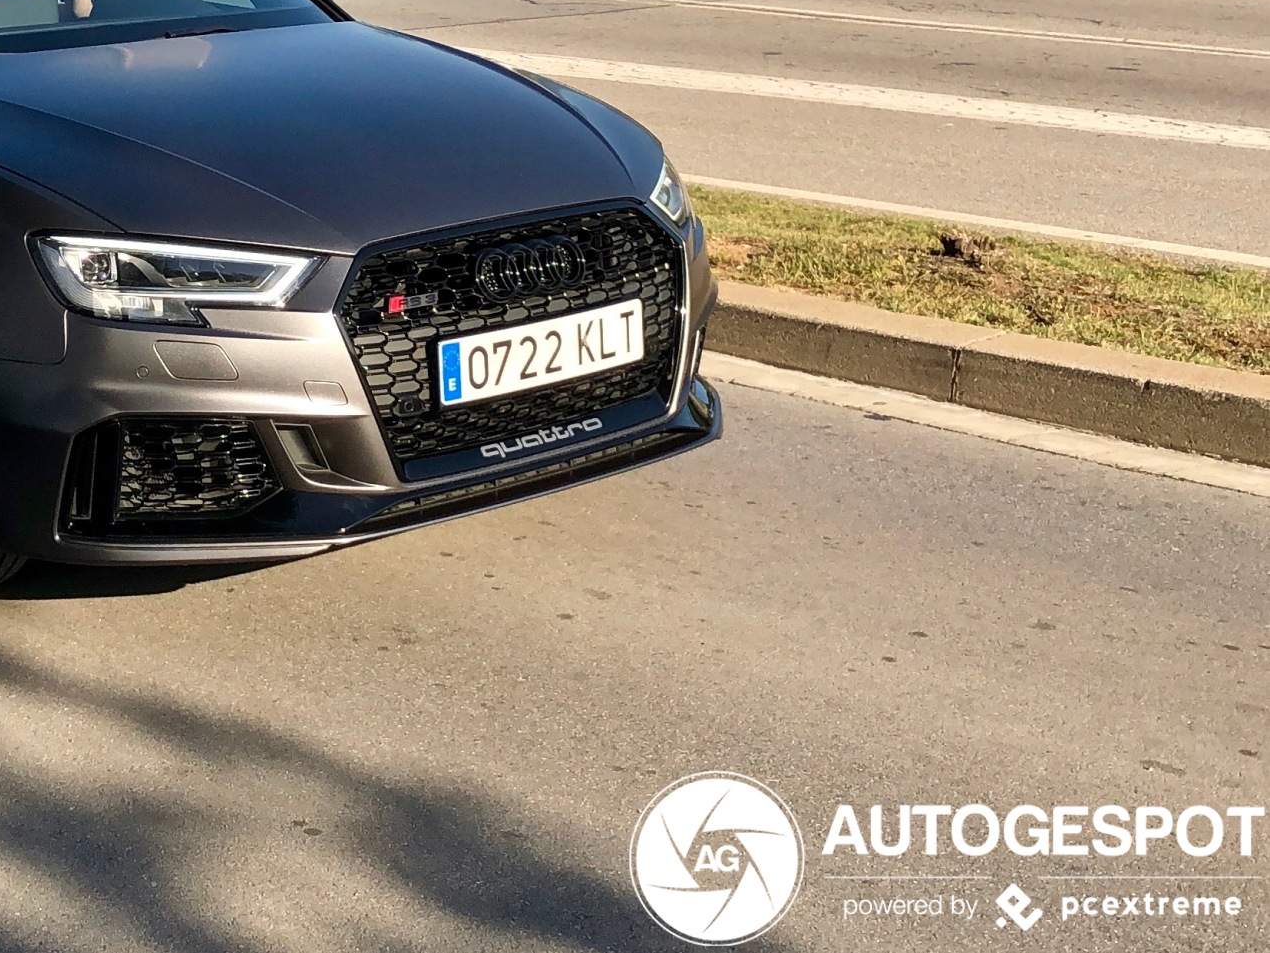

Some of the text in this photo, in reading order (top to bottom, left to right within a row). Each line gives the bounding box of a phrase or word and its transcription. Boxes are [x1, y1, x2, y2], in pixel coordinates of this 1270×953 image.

[448, 310, 634, 391] E 0722 KLT
[480, 417, 603, 458] quattro
